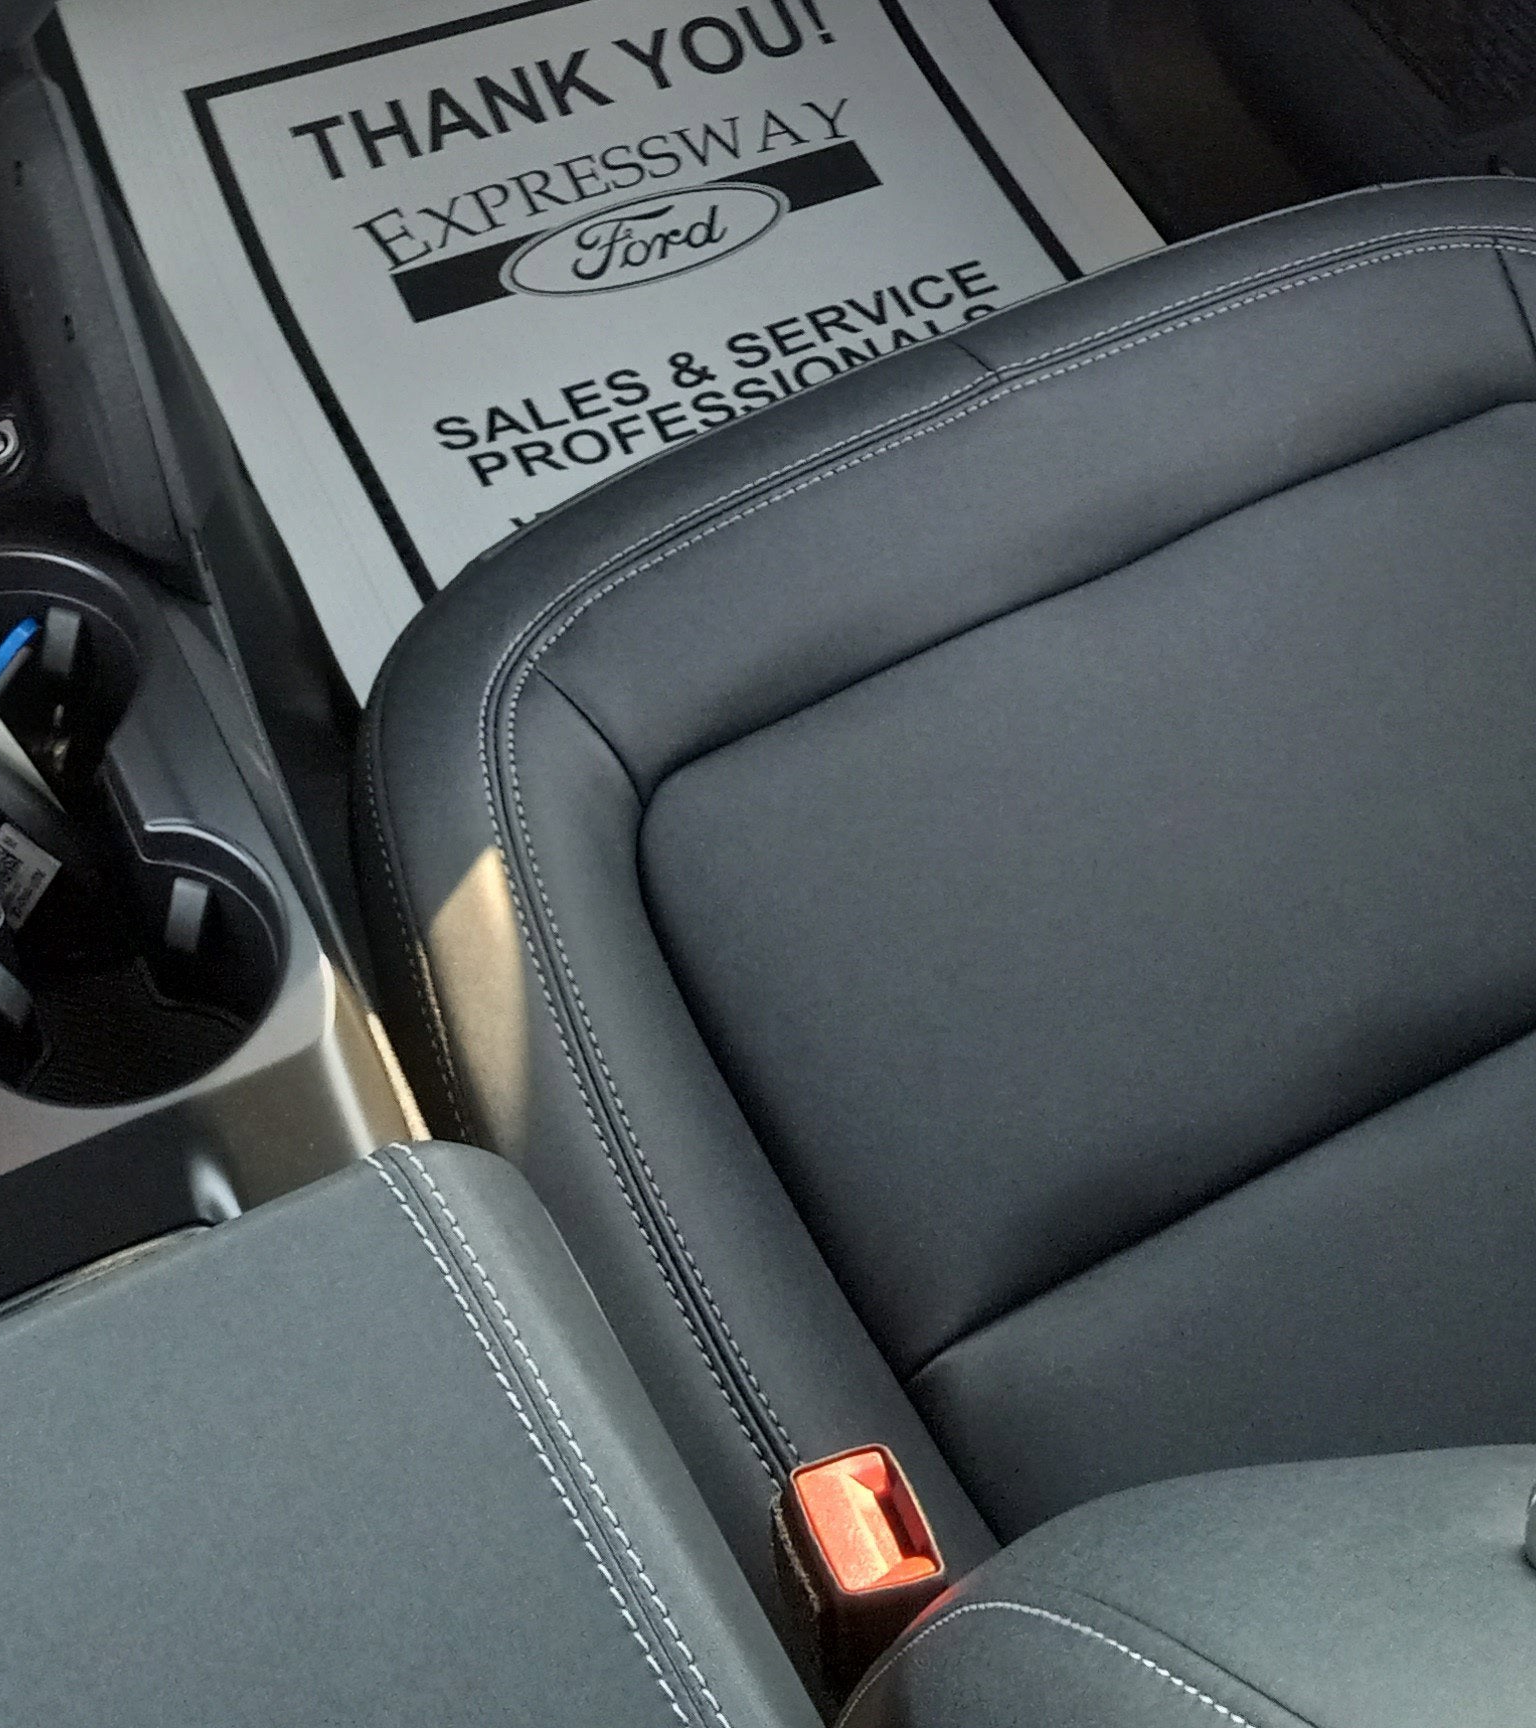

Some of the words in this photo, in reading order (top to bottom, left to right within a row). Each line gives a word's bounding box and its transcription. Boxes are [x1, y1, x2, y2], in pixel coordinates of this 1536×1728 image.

[288, 49, 615, 181] THANK
[352, 98, 850, 272] EXPRESSWAY
[570, 204, 728, 282] Ford
[433, 369, 651, 451] SALES
[668, 352, 718, 389] &
[725, 260, 1000, 369] SERVICE
